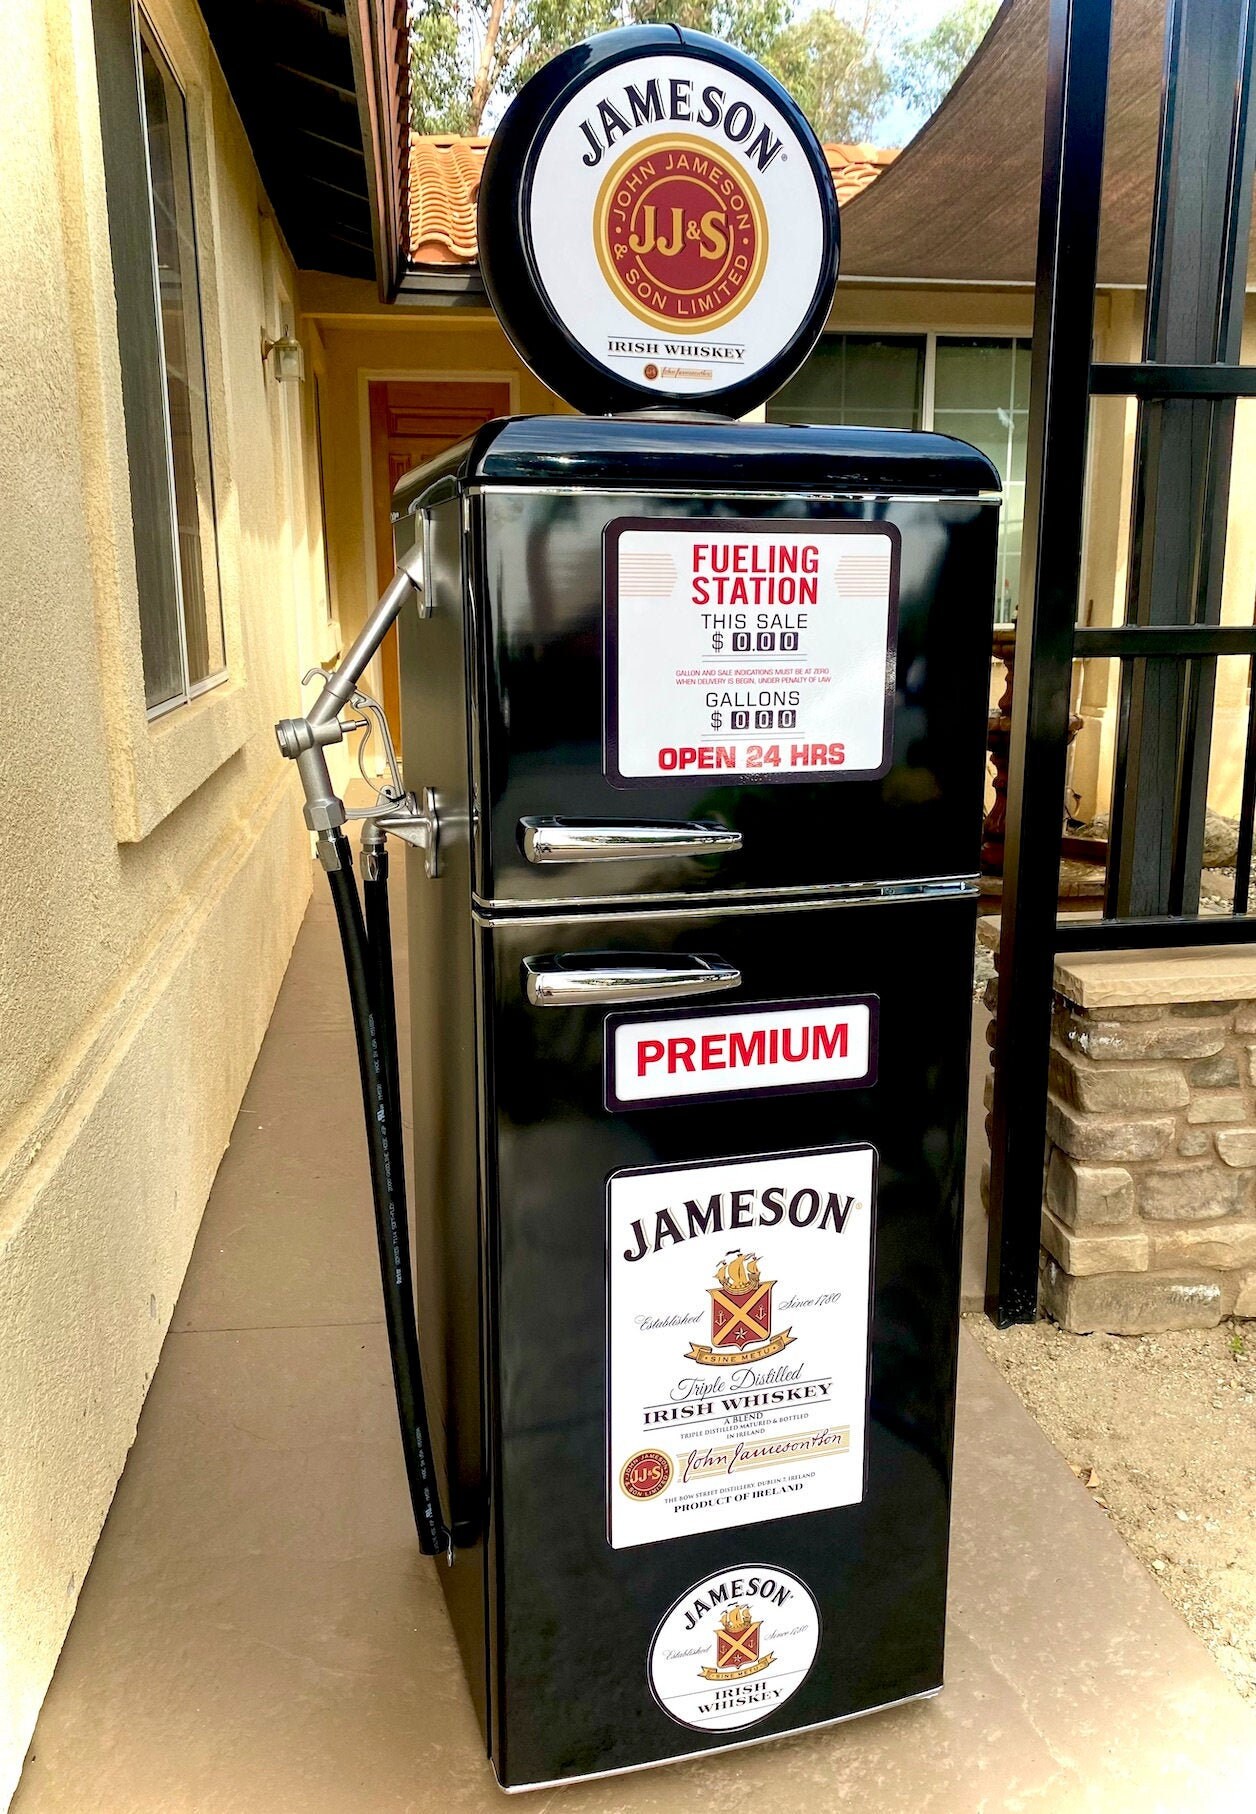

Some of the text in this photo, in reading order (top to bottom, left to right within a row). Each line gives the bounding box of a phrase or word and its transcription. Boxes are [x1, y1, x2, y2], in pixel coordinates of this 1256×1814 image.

[579, 78, 783, 173] JAMESON
[613, 154, 751, 230] JOHN JAMESON
[629, 205, 728, 260] JJ&S
[613, 243, 748, 315] & SON LIMITED
[608, 340, 746, 359] IRISH WHISKEY
[692, 544, 820, 574] FUELING
[691, 576, 818, 605] STATION
[701, 613, 808, 630] THIS SALE
[734, 668, 773, 676] INDICATIONS
[813, 667, 830, 675] ZERO
[705, 691, 800, 708] GALLONS
[658, 743, 846, 771] OPEN 24 HRS
[637, 1023, 849, 1077] PREMIUM
[623, 1187, 855, 1262] JAMESON
[778, 1292, 842, 1312] Since 1780
[634, 1311, 704, 1331] Established
[709, 1347, 770, 1363] SINE METU
[670, 1363, 805, 1401] Triple Distilled
[643, 1382, 833, 1425] IRISH WHISKEY
[680, 1431, 703, 1440] TRIPLE
[704, 1425, 739, 1436] DISTILLED
[739, 1419, 772, 1429] MATURED
[779, 1413, 809, 1423] BOTTLED
[732, 1412, 764, 1424] BLEND
[736, 1428, 766, 1438] IRELAND
[683, 1448, 728, 1483] John
[674, 1483, 803, 1513] PRODUCT OF IRELAND
[695, 1489, 718, 1498] STREET
[757, 1479, 781, 1487] DUBLIN
[788, 1472, 816, 1481] IRELAND
[684, 1577, 790, 1631] JAMESON
[662, 1645, 712, 1661] Established
[697, 1688, 784, 1714] WHISKEY
[715, 1682, 767, 1700] IRISH
